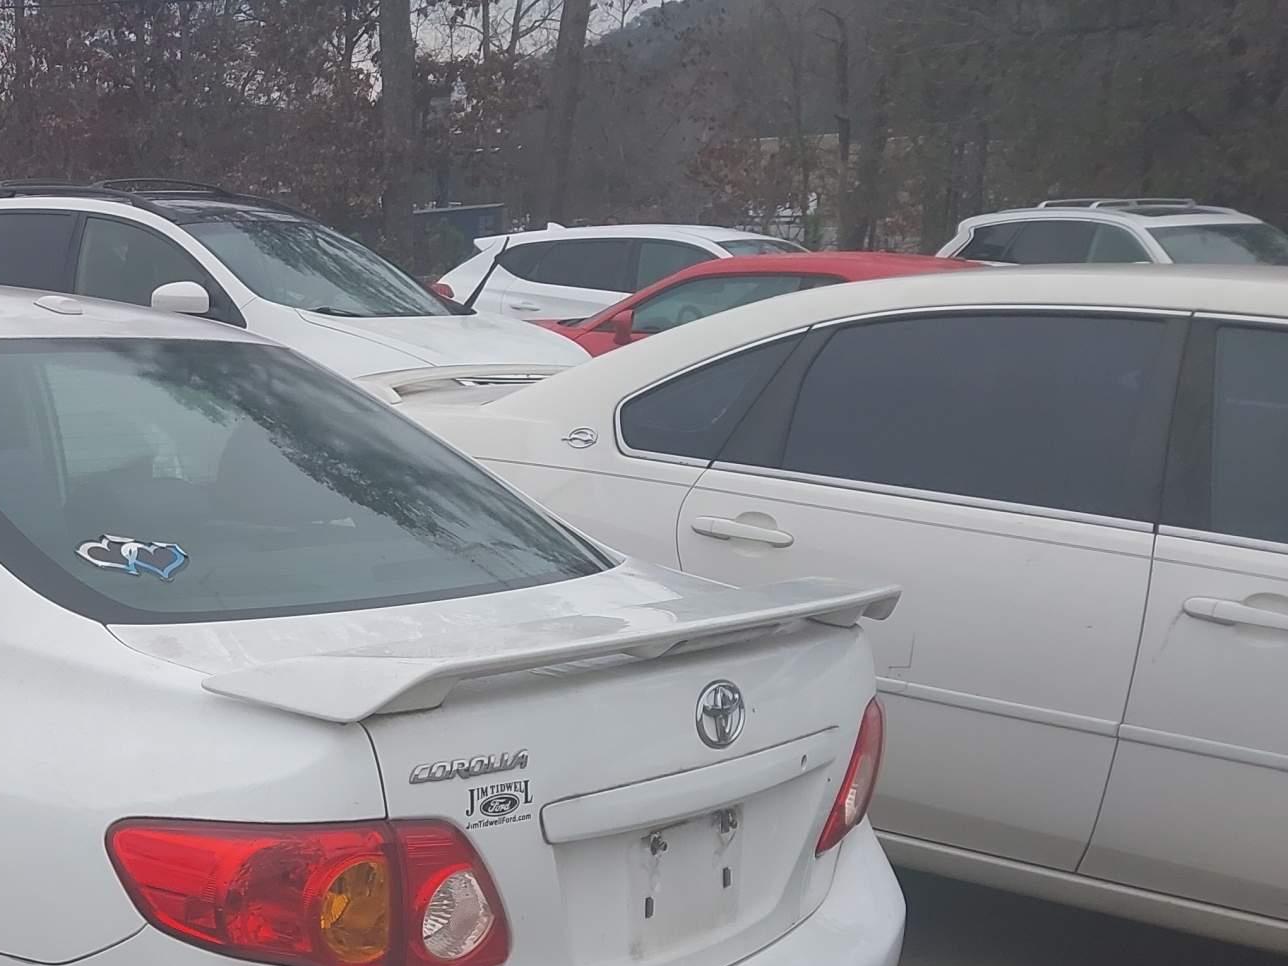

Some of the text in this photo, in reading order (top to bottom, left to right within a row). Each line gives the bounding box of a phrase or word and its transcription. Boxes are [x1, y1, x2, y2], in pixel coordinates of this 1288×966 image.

[409, 748, 528, 784] COROLLA
[466, 780, 533, 816] JIM TIDWELL
[466, 813, 532, 830] JimTidwellFord.com
